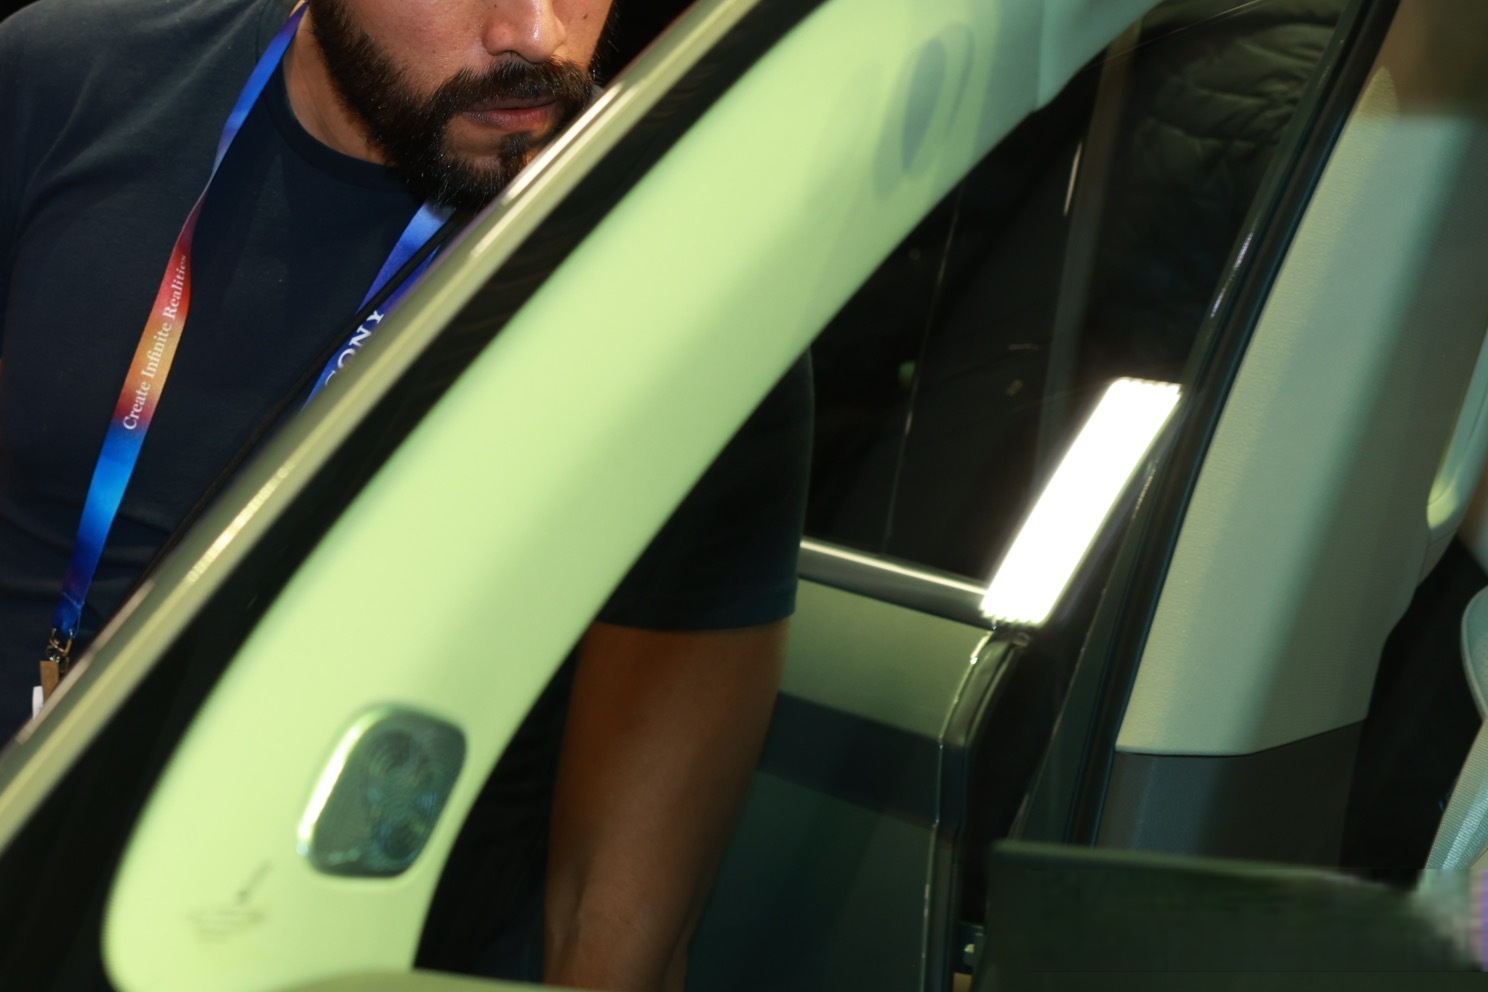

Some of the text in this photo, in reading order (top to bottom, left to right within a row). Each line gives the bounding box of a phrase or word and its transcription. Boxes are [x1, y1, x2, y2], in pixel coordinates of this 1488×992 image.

[123, 255, 187, 430] Create Infinite Realities
